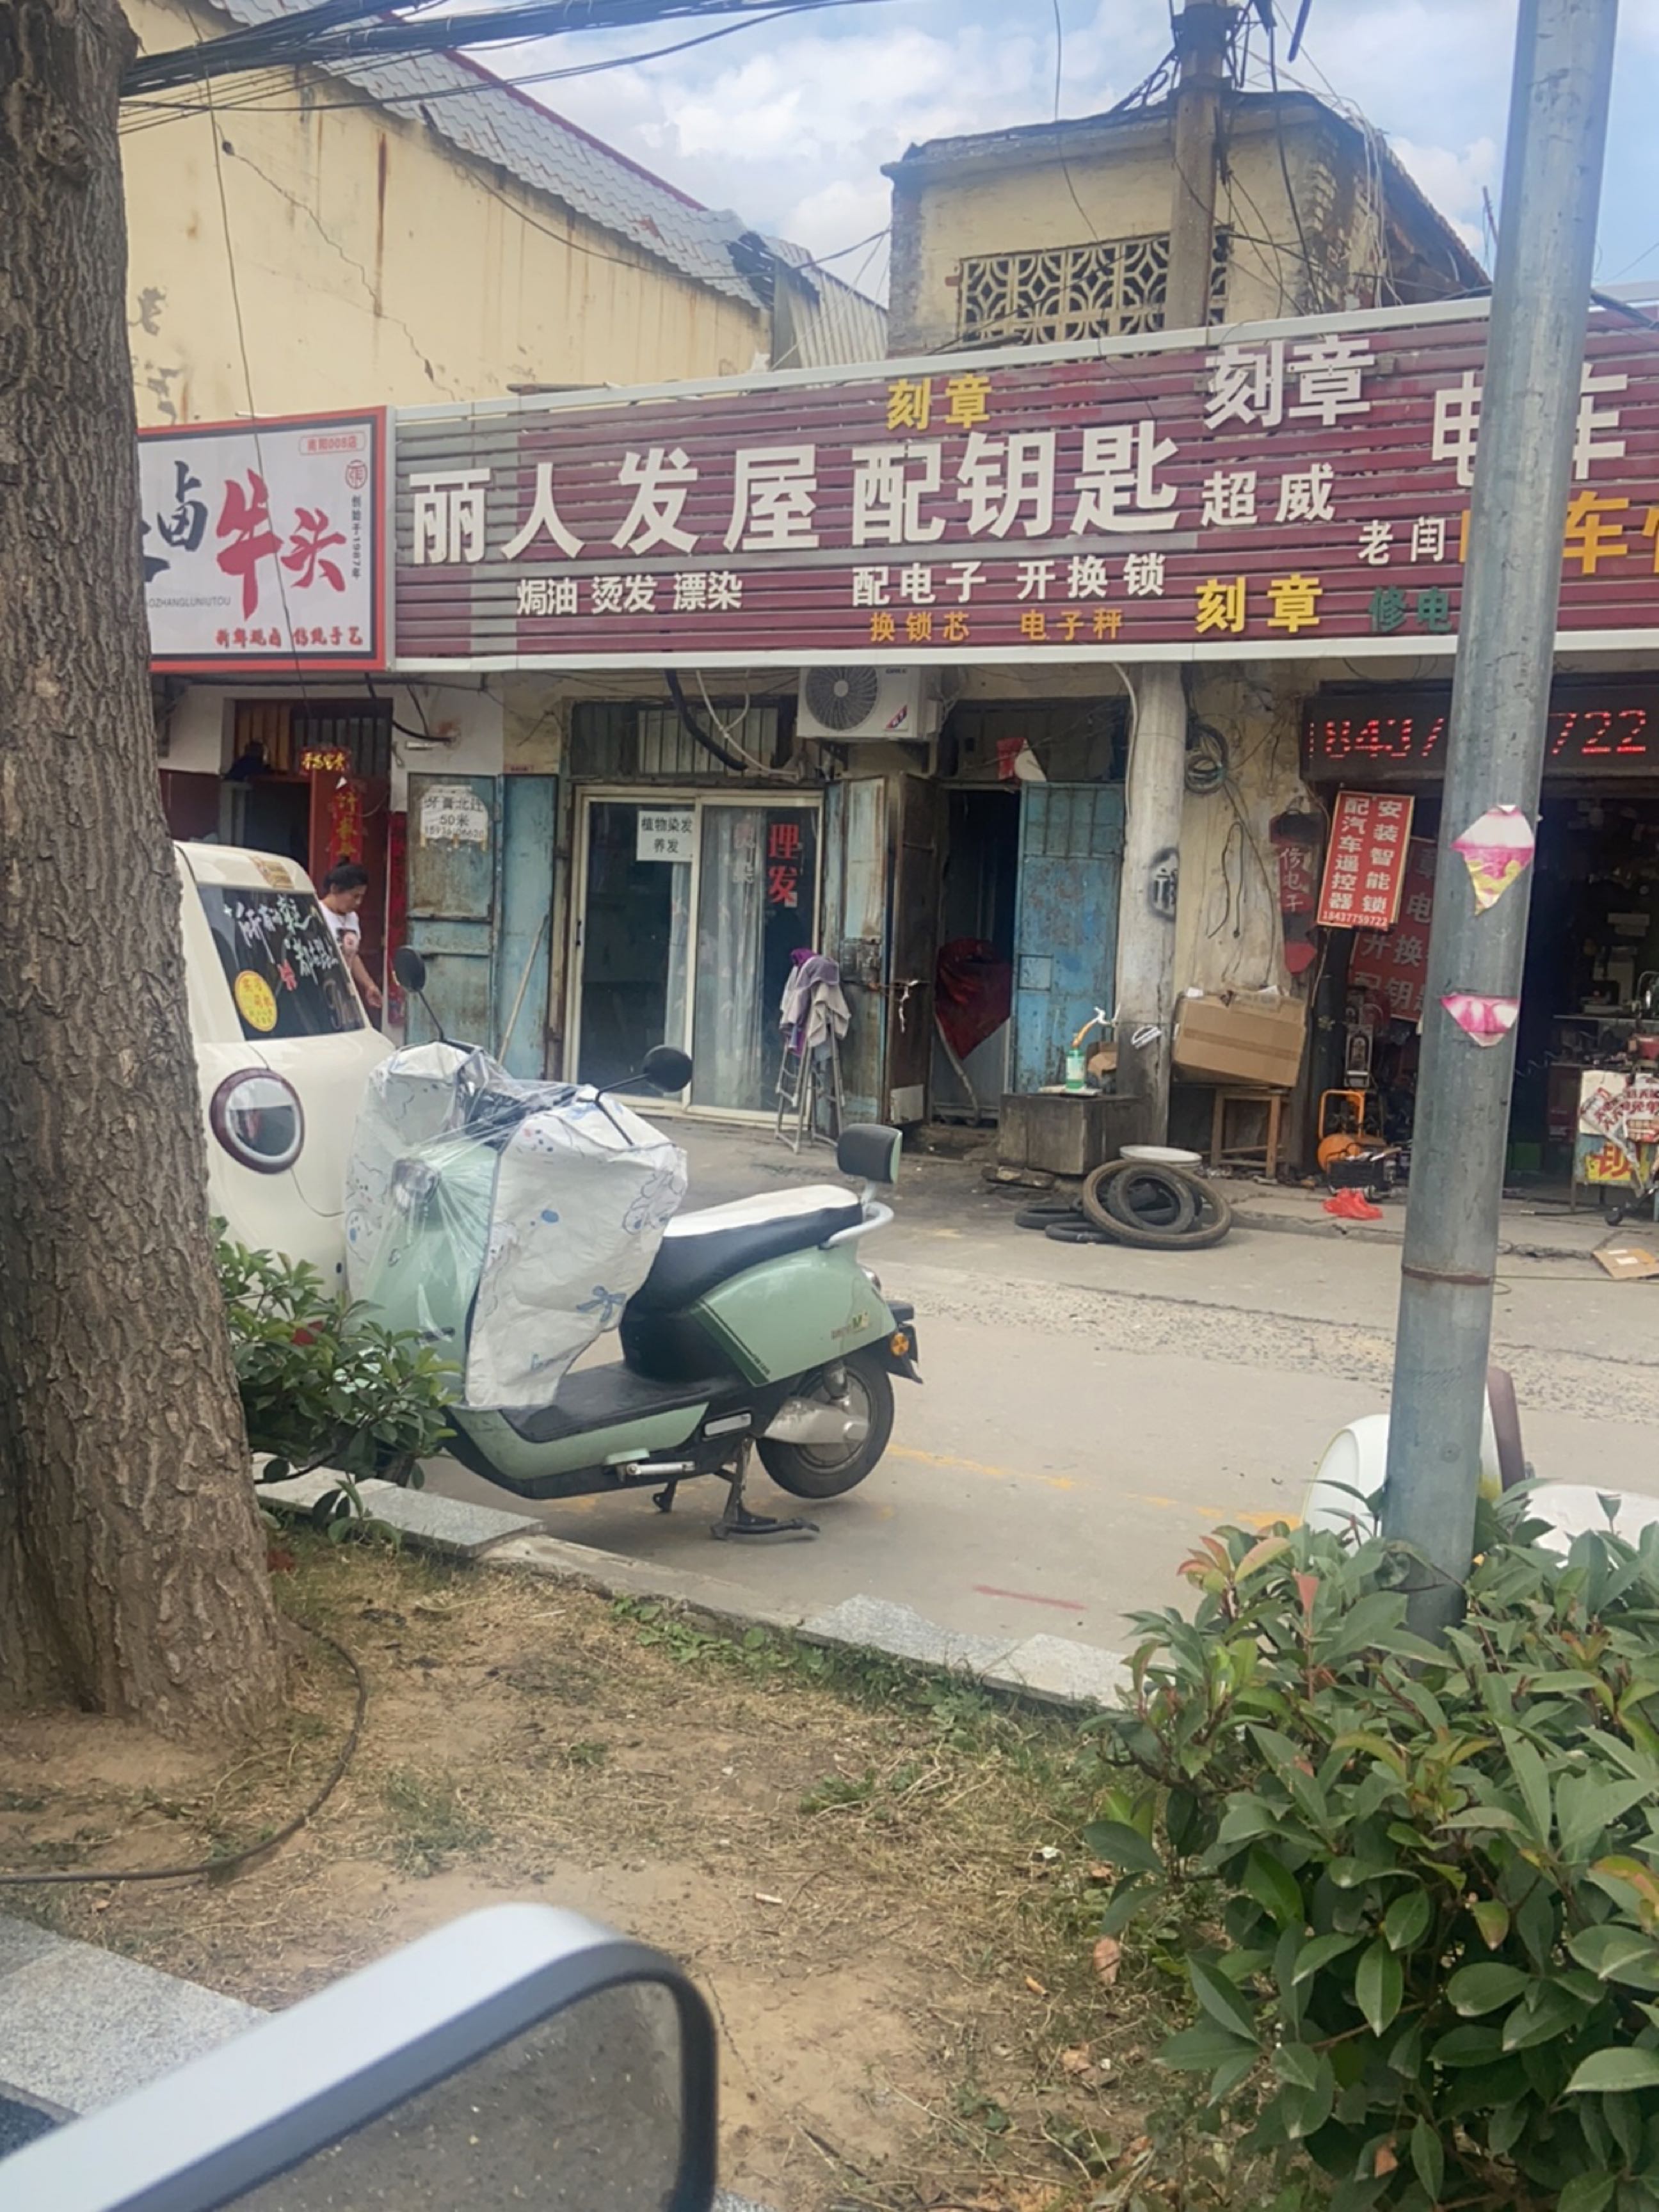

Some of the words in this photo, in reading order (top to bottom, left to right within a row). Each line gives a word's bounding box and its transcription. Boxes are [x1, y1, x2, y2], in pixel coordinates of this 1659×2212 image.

[885, 373, 993, 431] 刻章
[1203, 335, 1375, 429] 刻章
[409, 444, 820, 565] 丽人发屋
[851, 420, 1180, 546] 配钥匙
[1200, 462, 1336, 527] 超威
[516, 579, 578, 615] 焗油
[590, 575, 657, 613] 烫发
[673, 570, 742, 611] 漂染
[852, 561, 986, 606] 配电子
[1016, 552, 1166, 600] 开换锁
[1194, 573, 1323, 634] 刻章
[870, 611, 970, 642] 换锁芯
[1020, 607, 1123, 641] 电子秤
[641, 816, 693, 833] 植物染发
[653, 838, 679, 853] 养发
[1329, 797, 1370, 910] 配汽车遥控器
[768, 823, 801, 904] 理发
[1363, 801, 1402, 914] 安装智能锁
[1360, 933, 1429, 968] 开换
